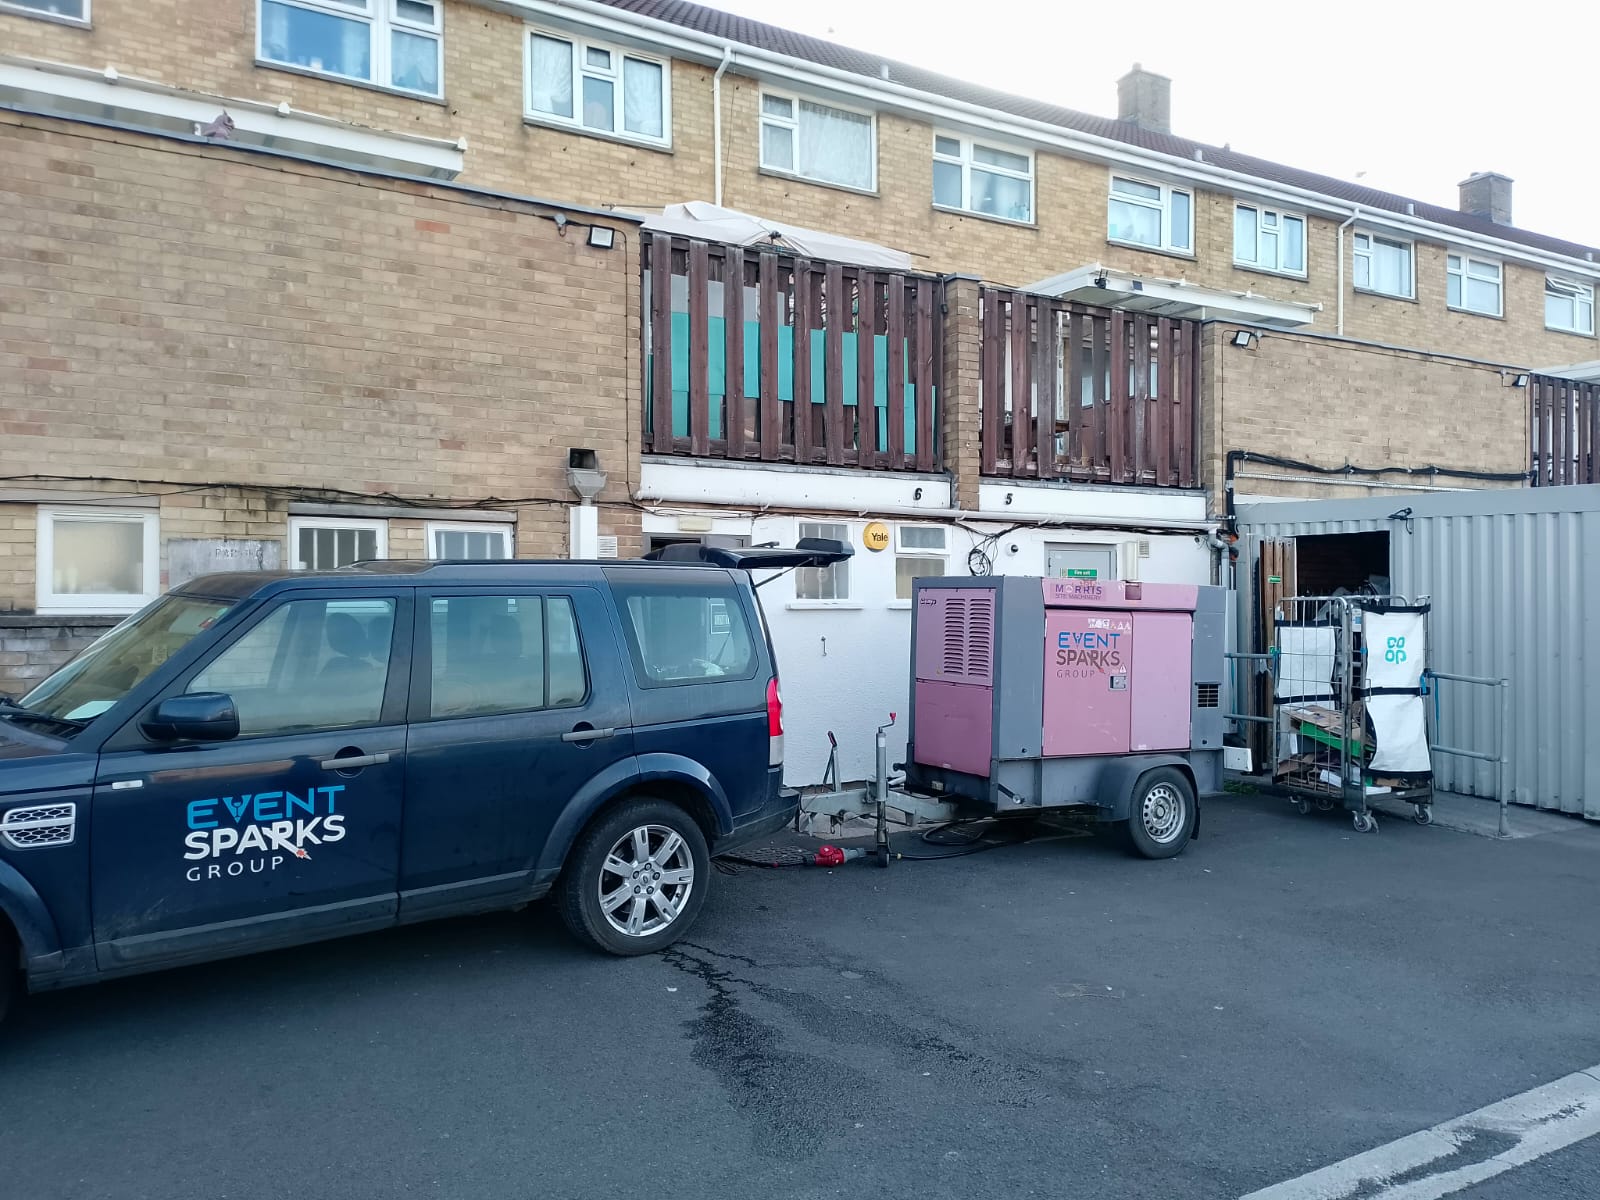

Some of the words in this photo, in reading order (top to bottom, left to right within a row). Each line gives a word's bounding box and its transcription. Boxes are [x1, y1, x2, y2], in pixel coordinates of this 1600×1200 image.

[915, 488, 923, 500] 6
[1005, 493, 1014, 505] 5
[871, 532, 889, 542] Yale
[1055, 584, 1103, 595] MORRIS
[1058, 631, 1121, 649] EVENT
[1056, 649, 1121, 674] SPARKS
[1056, 669, 1096, 679] GROUP
[187, 785, 346, 830] EVENT
[183, 815, 346, 861] SPARKS
[186, 856, 284, 882] GROUP
